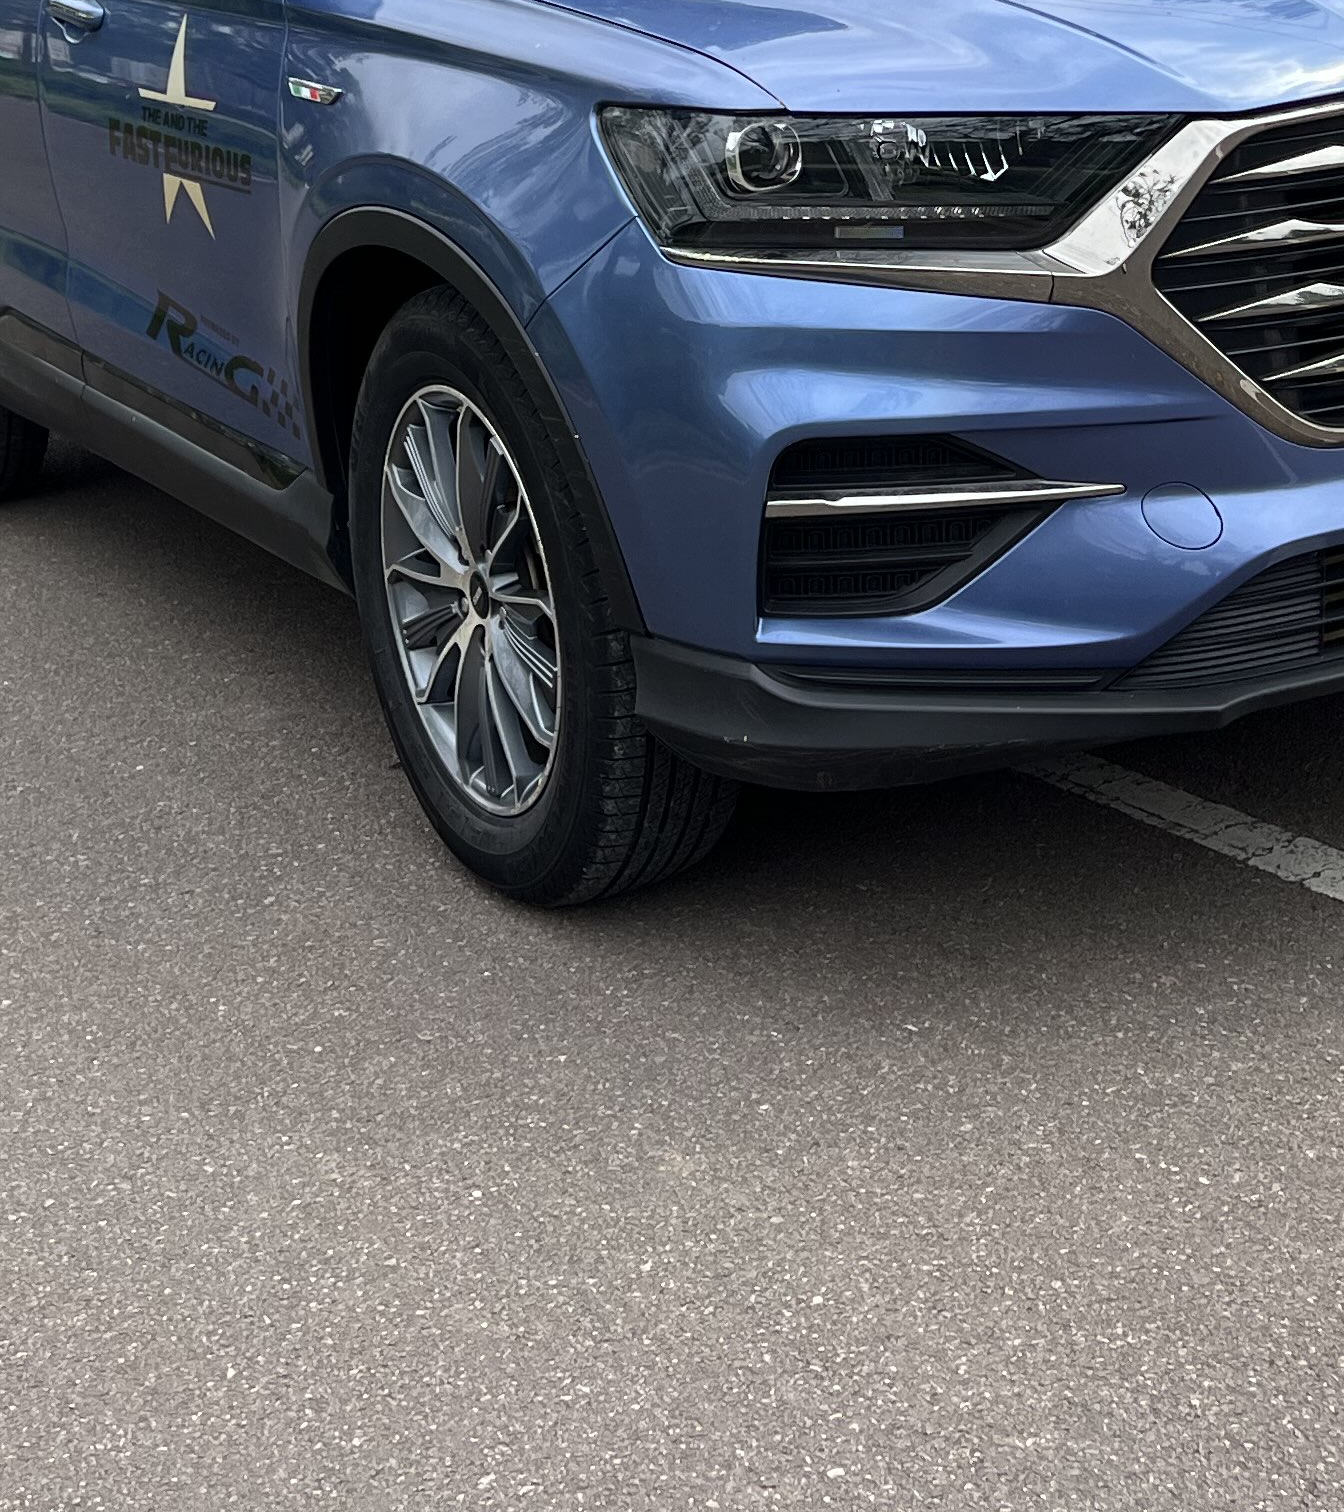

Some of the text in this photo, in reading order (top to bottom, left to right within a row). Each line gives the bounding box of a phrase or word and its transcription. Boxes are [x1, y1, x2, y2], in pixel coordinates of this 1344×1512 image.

[142, 106, 209, 137] THE AND THE
